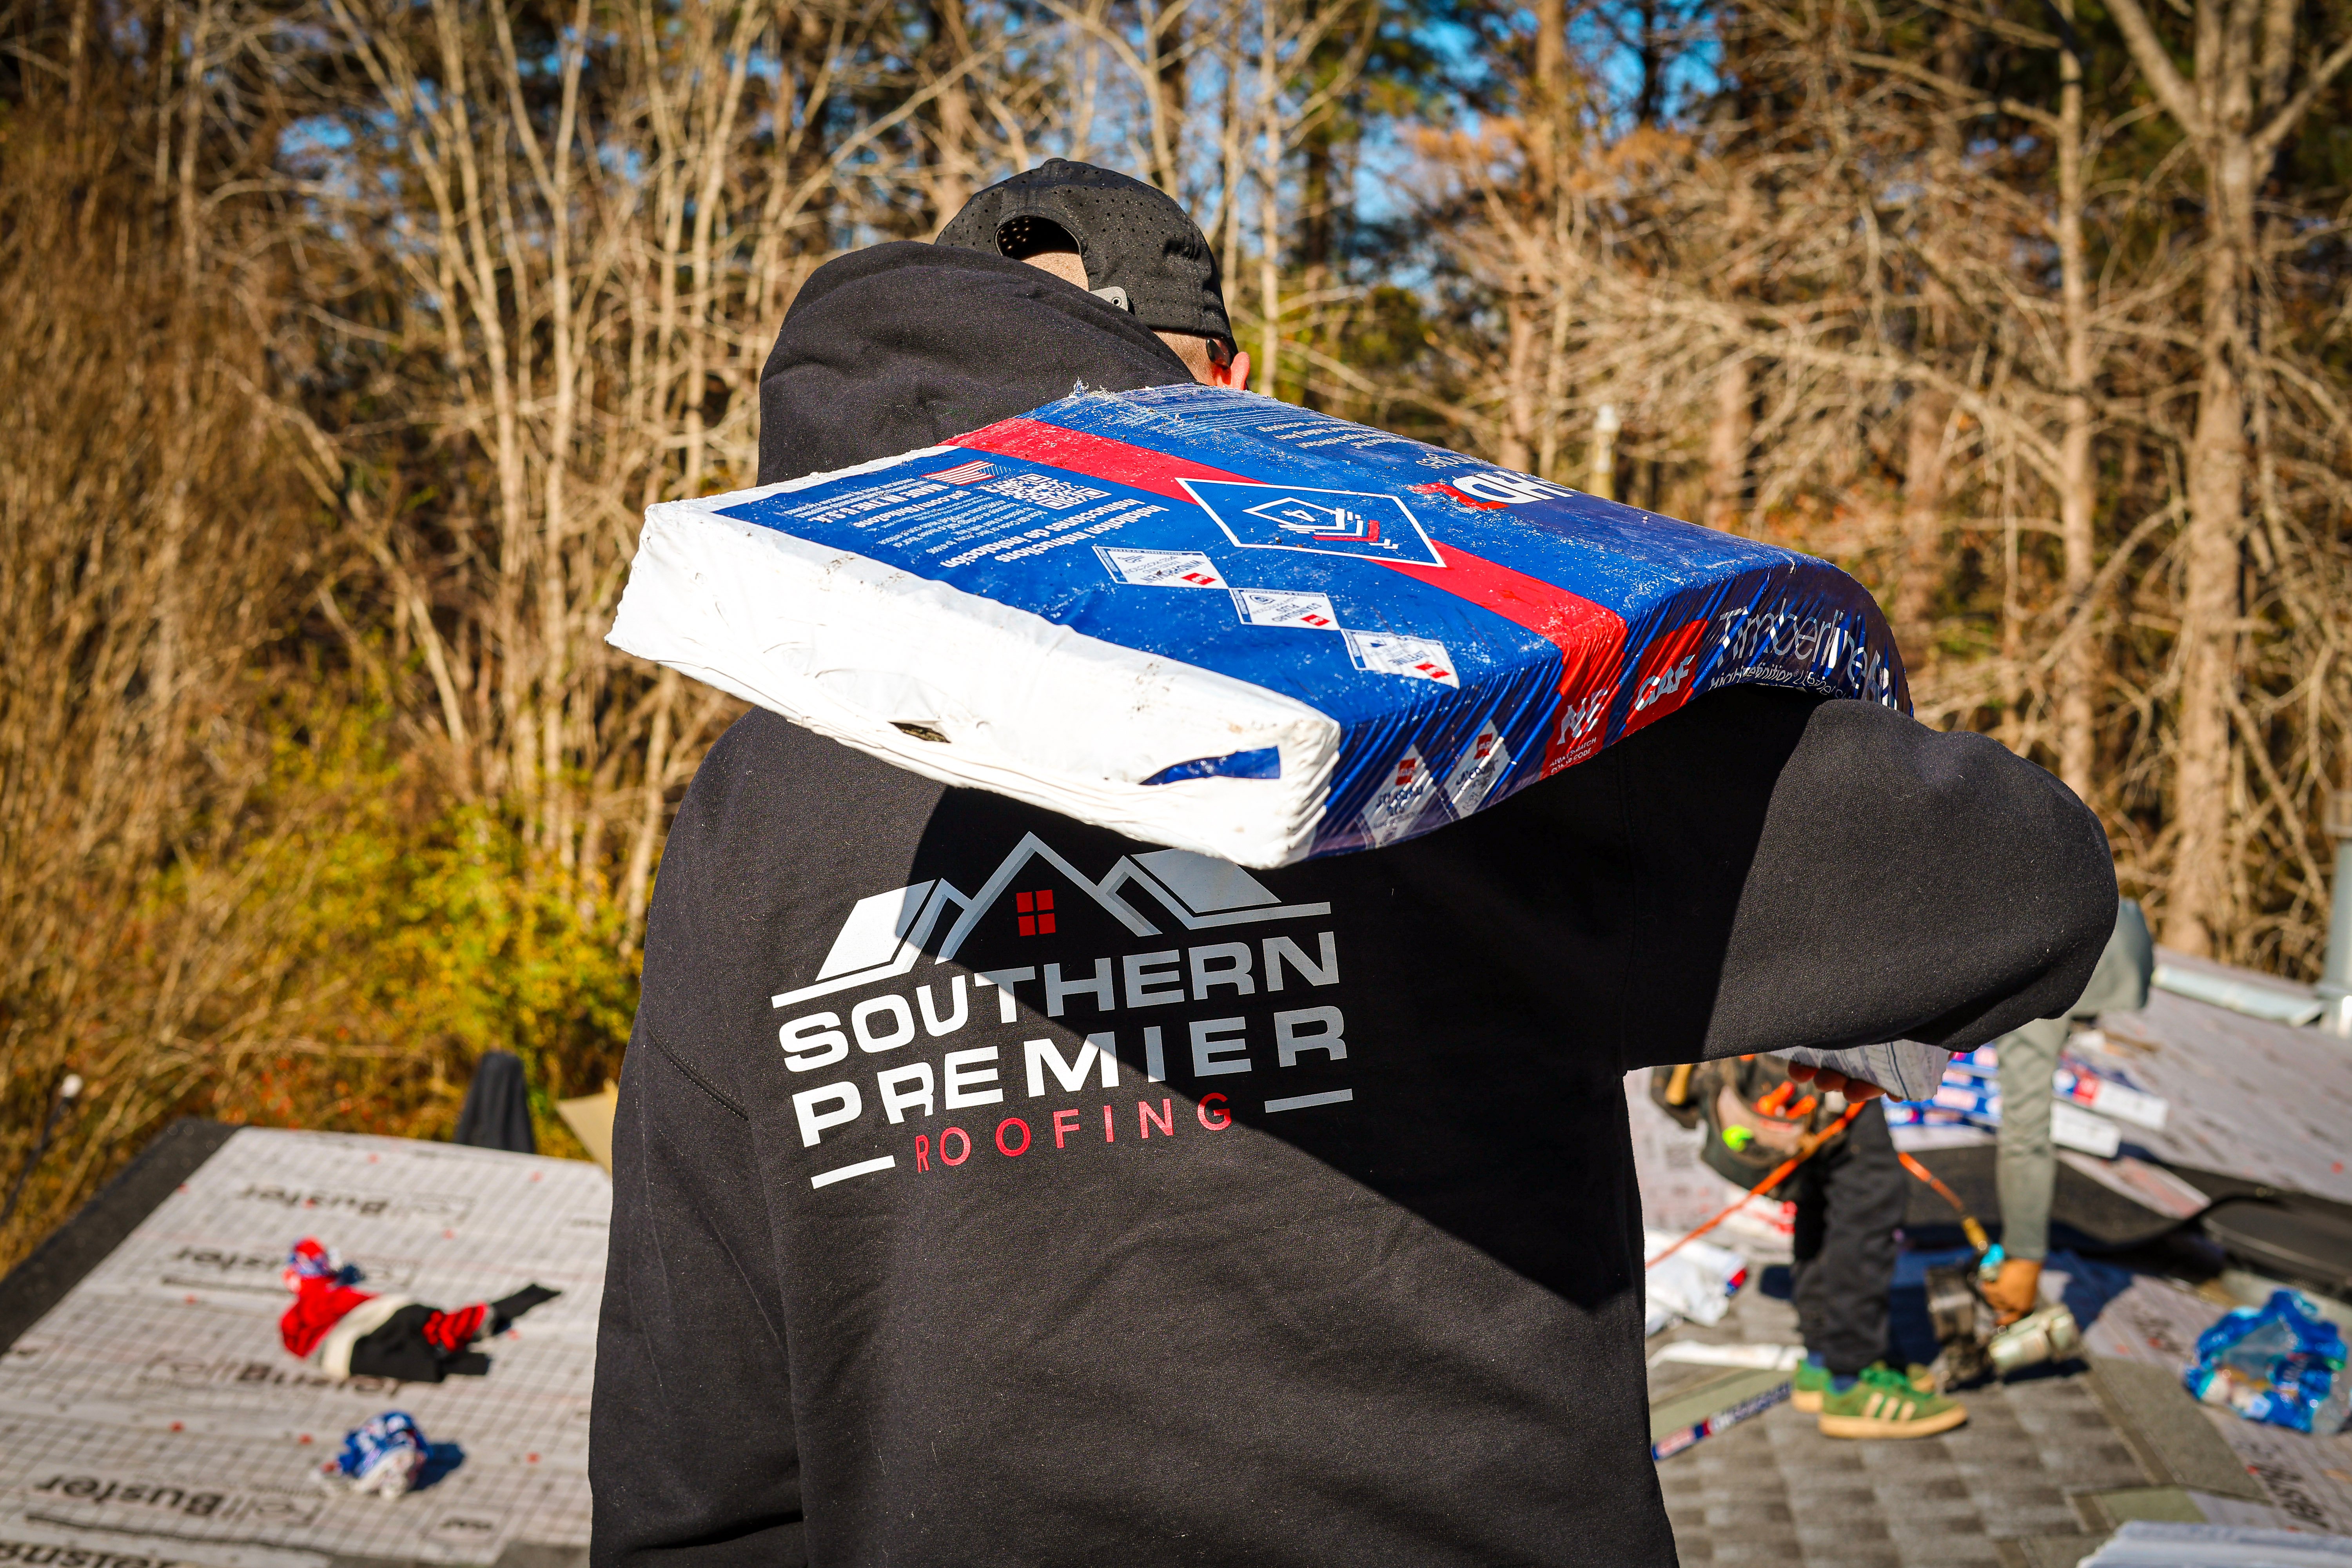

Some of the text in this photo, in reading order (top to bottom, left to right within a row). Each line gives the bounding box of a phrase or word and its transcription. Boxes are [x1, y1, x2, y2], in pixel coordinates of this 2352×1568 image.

[1256, 422, 1310, 432] Technology
[1293, 428, 1332, 436] Nailing
[1416, 454, 1494, 469] hingles
[880, 478, 916, 489] AMERICAN
[808, 484, 949, 523] MADE IN THE U.S.A.
[819, 493, 855, 505] AMERICAN
[981, 500, 1006, 508] 41595
[854, 490, 970, 527] gaf.com/StrikeZone
[967, 506, 989, 514] para
[988, 503, 1020, 514] Escanee
[1000, 508, 1025, 520] receive
[1025, 510, 1048, 518] Scan
[1085, 505, 1168, 534] Installation
[1282, 509, 1316, 524] 4
[998, 520, 1020, 529] Code
[941, 499, 1144, 567] Instrucciones de instalación
[926, 544, 949, 554] 41595
[995, 532, 1094, 562] instructions
[1635, 655, 1695, 711] GAF
[1708, 669, 1742, 691] High
[1575, 737, 1597, 753] MATCH
[1573, 748, 1592, 761] CODE
[778, 931, 1340, 1073] SOUTHERN
[791, 1005, 1348, 1148] PREMIER
[915, 1092, 1232, 1174] ROOFING
